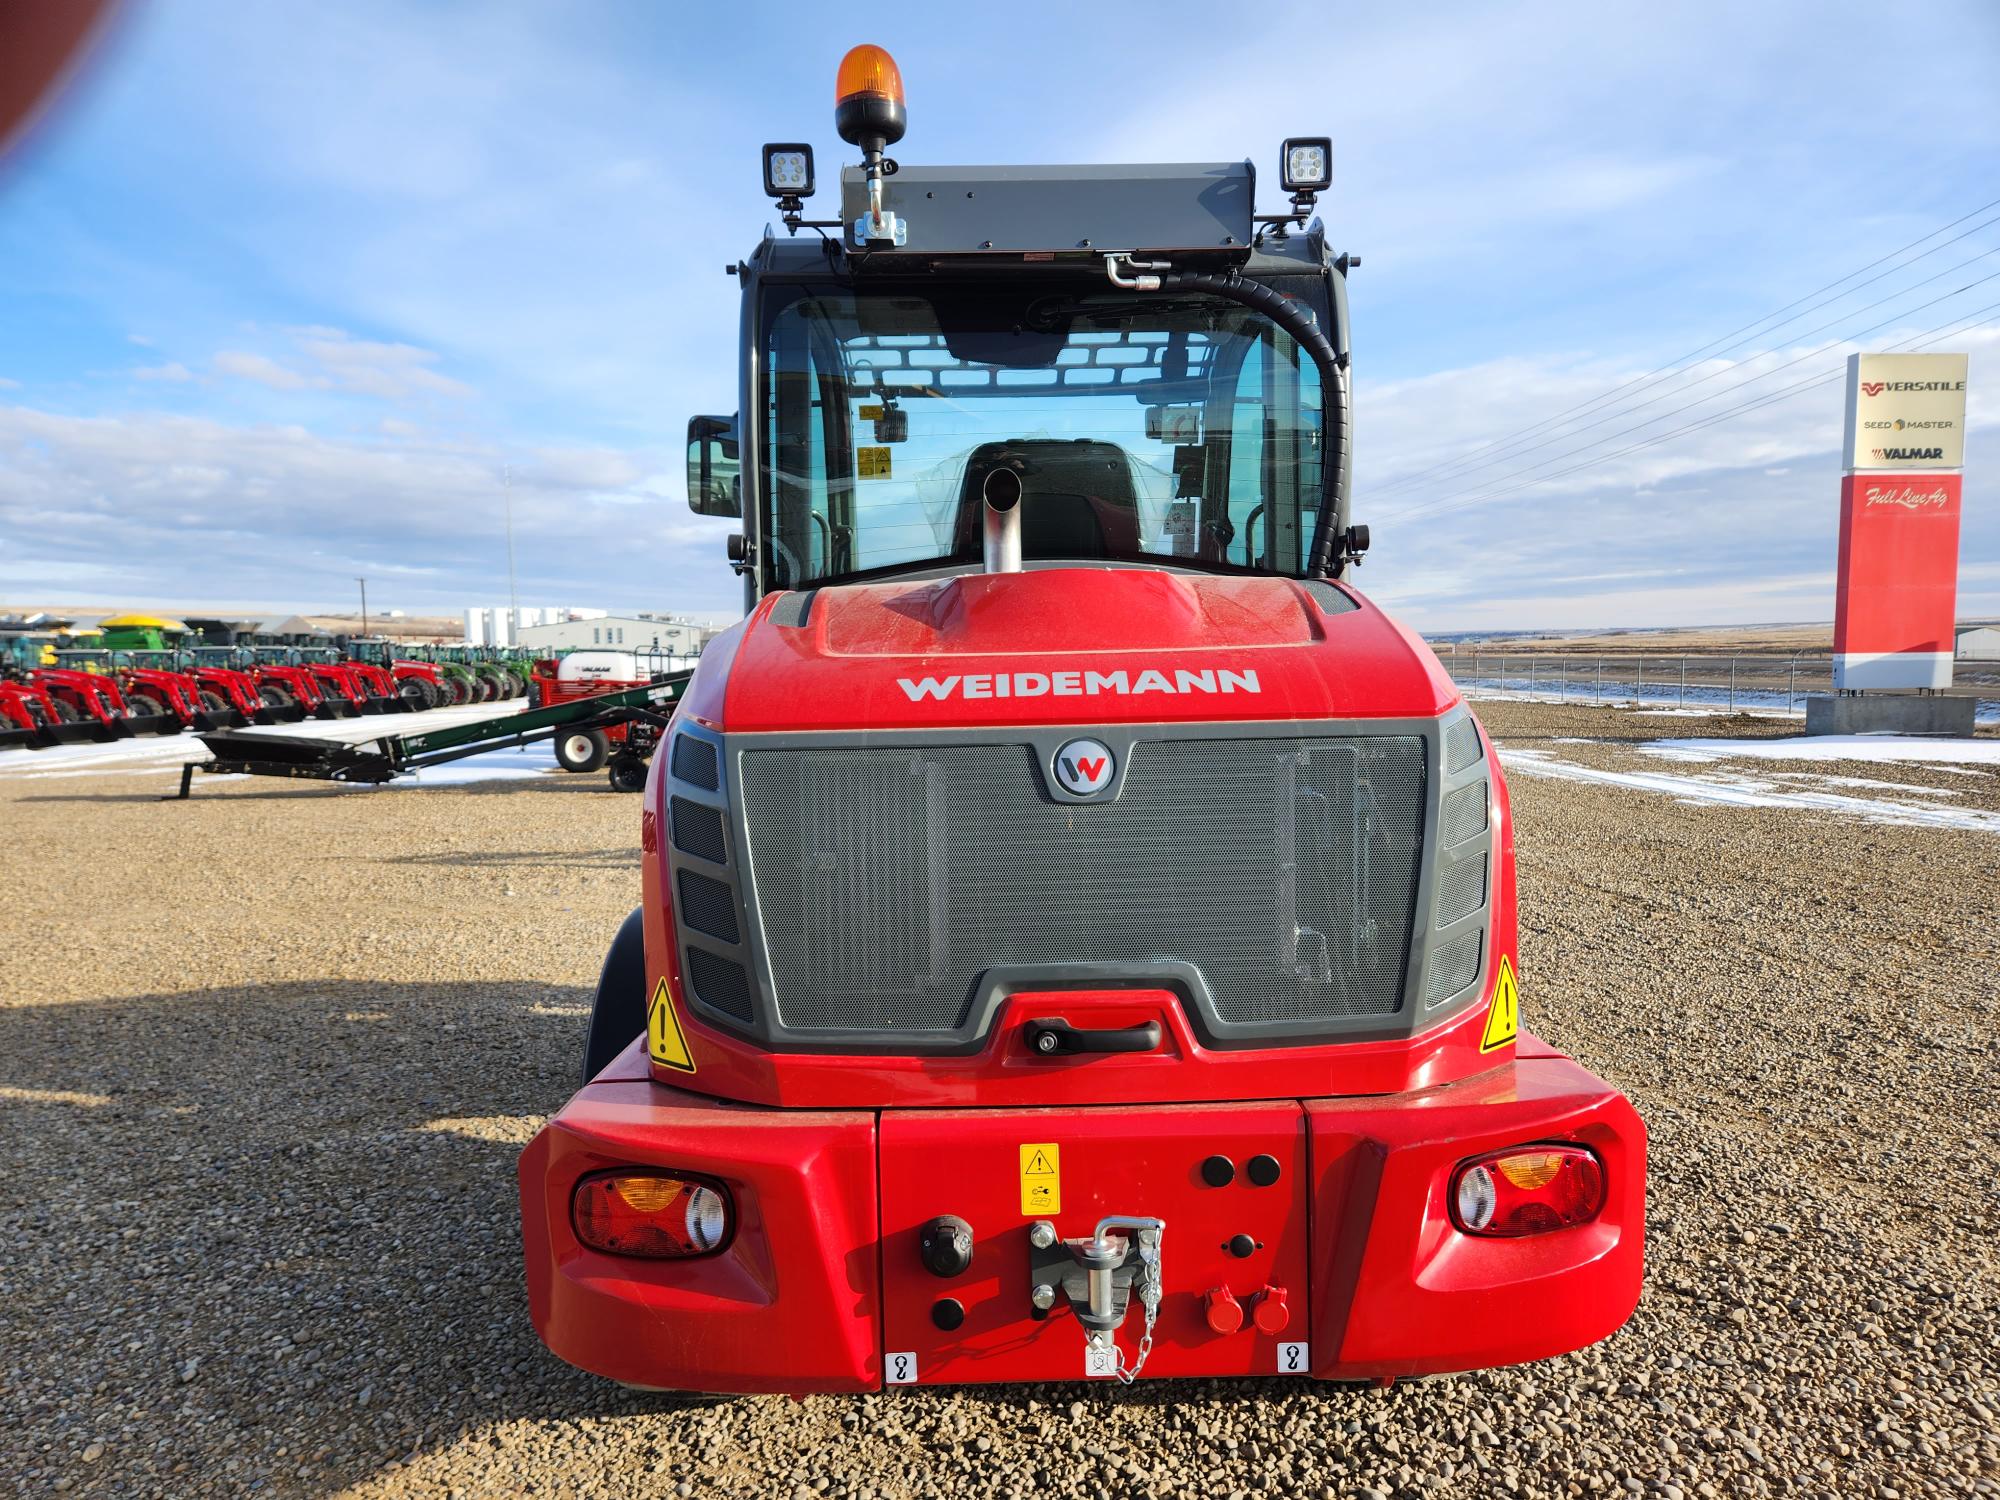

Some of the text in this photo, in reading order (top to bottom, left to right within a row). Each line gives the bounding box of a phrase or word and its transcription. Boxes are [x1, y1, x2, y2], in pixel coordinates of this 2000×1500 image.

[1886, 381, 1965, 391] VERSATILE
[1864, 421, 1953, 429] SEED MASTER
[1883, 448, 1943, 460] VALMAR
[1866, 487, 1947, 509] Full Line Ag
[896, 669, 1262, 702] WEIDEMANN
